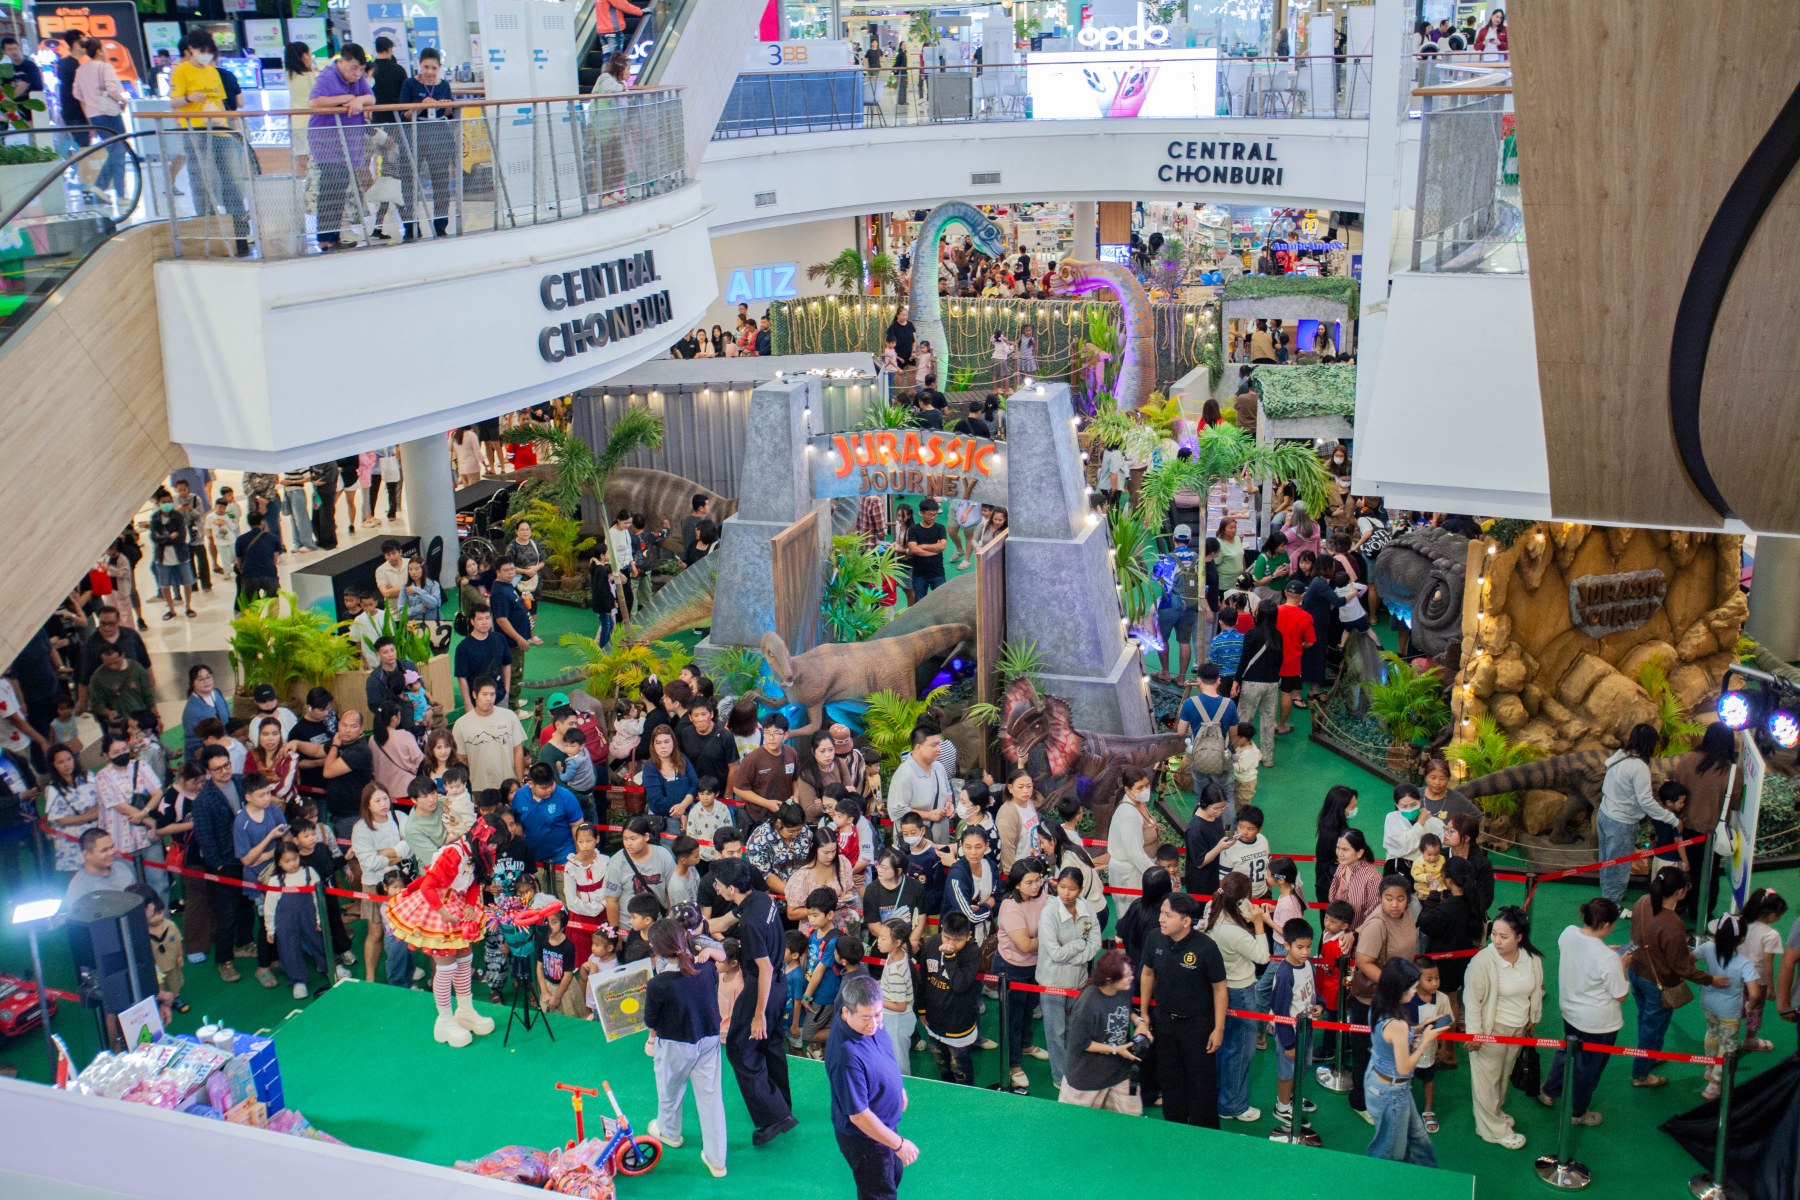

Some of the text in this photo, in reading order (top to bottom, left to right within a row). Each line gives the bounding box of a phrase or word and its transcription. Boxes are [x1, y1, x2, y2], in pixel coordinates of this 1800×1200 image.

[381, 5, 388, 17] 2
[38, 15, 117, 38] PRO
[1077, 25, 1169, 50] oppo
[1167, 141, 1278, 161] CENTRAL
[1158, 164, 1283, 186] CHONBURI
[540, 249, 662, 311] CENTRAL
[538, 289, 674, 362] CHONBURI
[832, 431, 996, 479] JURASSIC
[858, 468, 977, 500] JOURNEY
[1576, 576, 1666, 610] JURASSIC
[1249, 859, 1265, 882] 12
